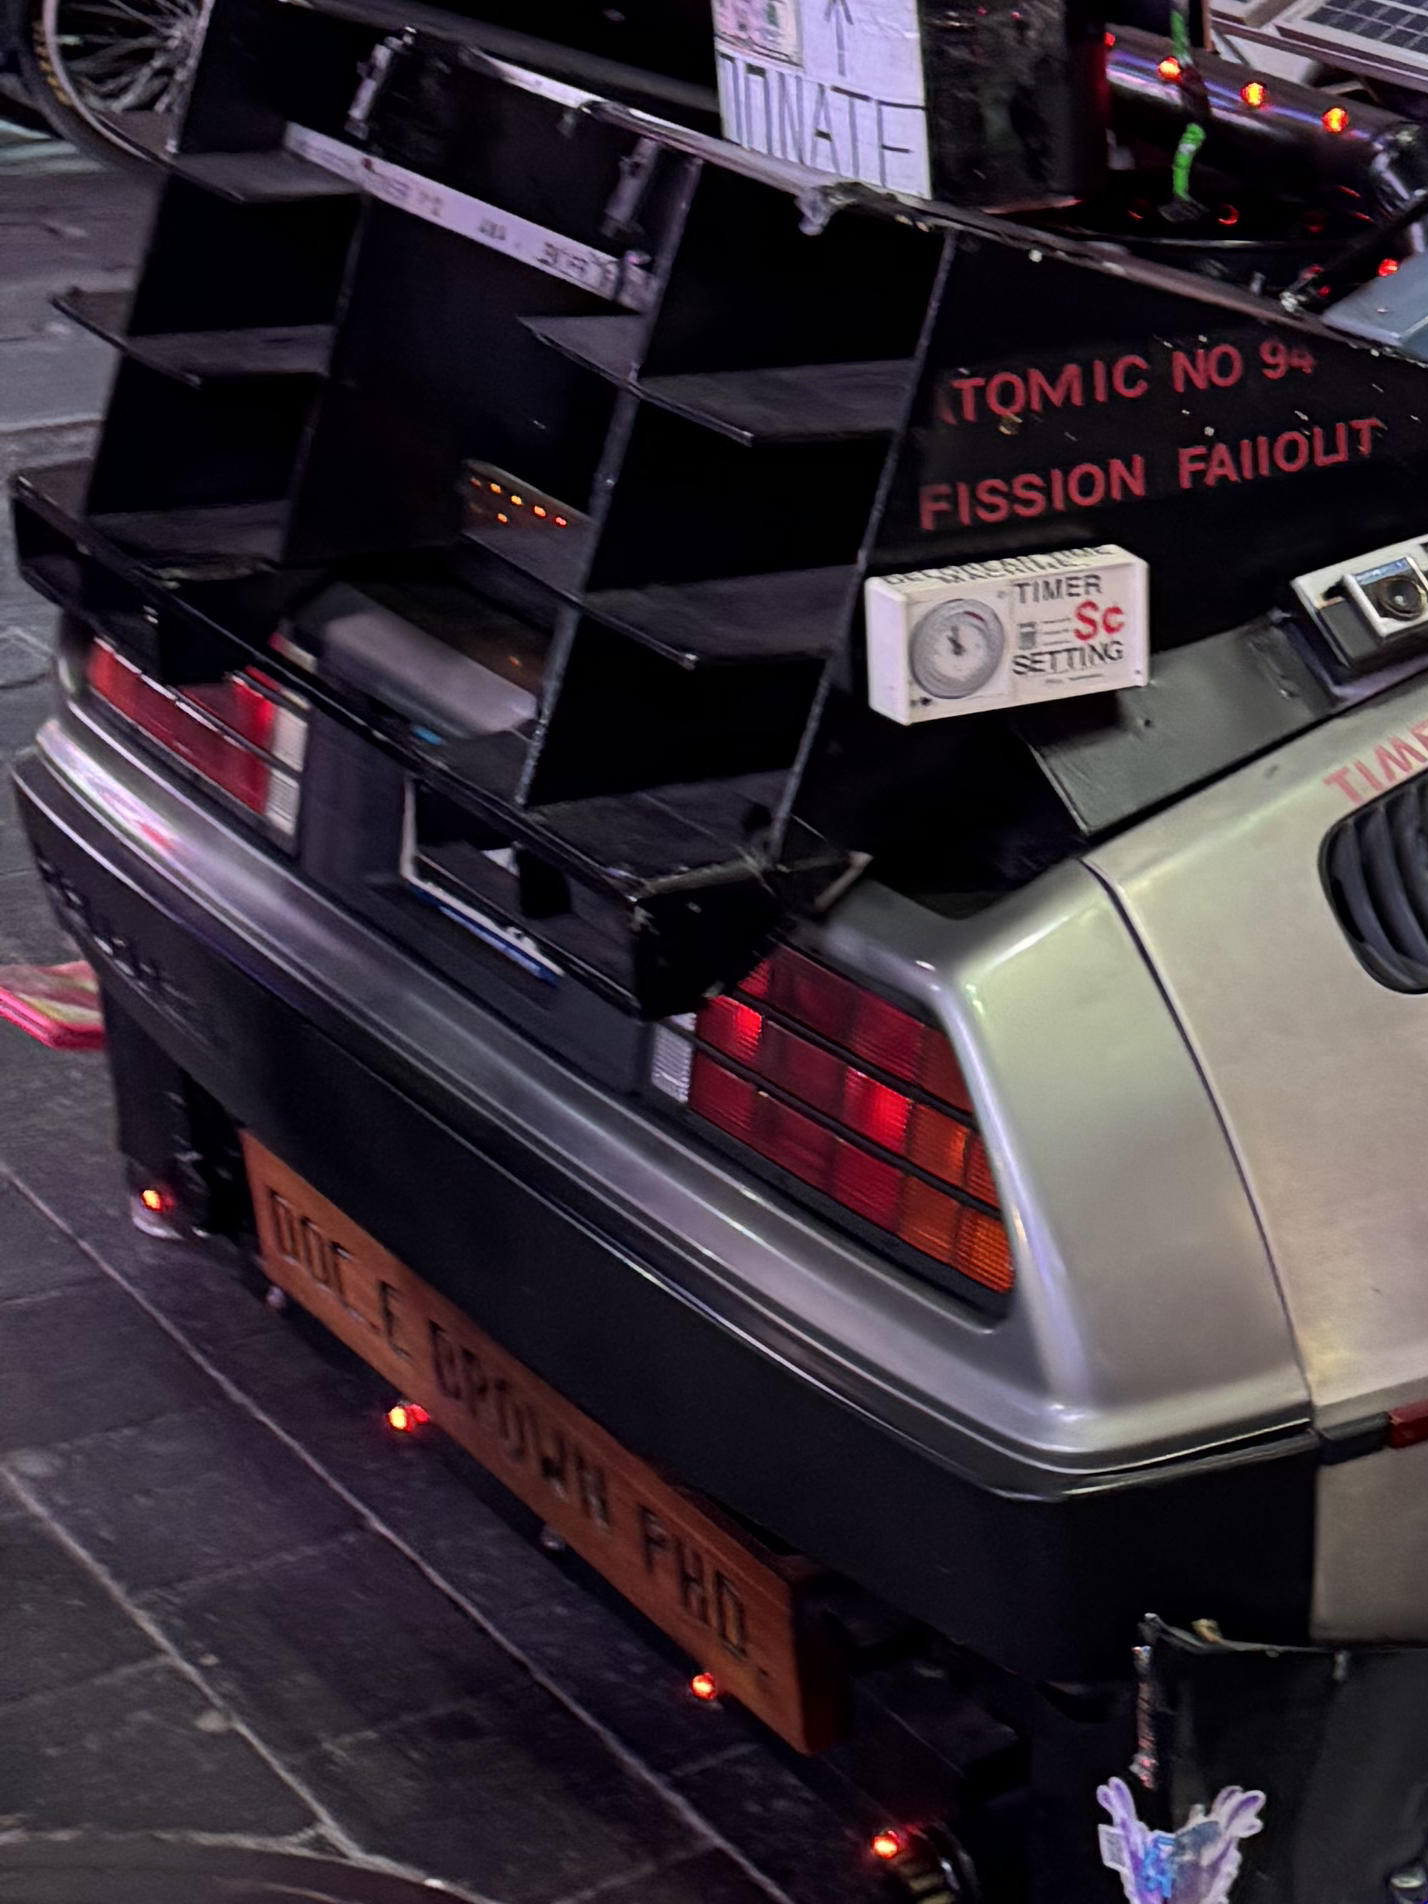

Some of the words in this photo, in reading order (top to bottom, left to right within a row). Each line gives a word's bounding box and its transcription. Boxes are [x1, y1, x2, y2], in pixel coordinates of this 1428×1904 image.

[1171, 344, 1243, 393] NO
[919, 453, 1146, 532] FISSION
[1015, 574, 1103, 604] TIMER
[1012, 640, 1125, 676] SETTING
